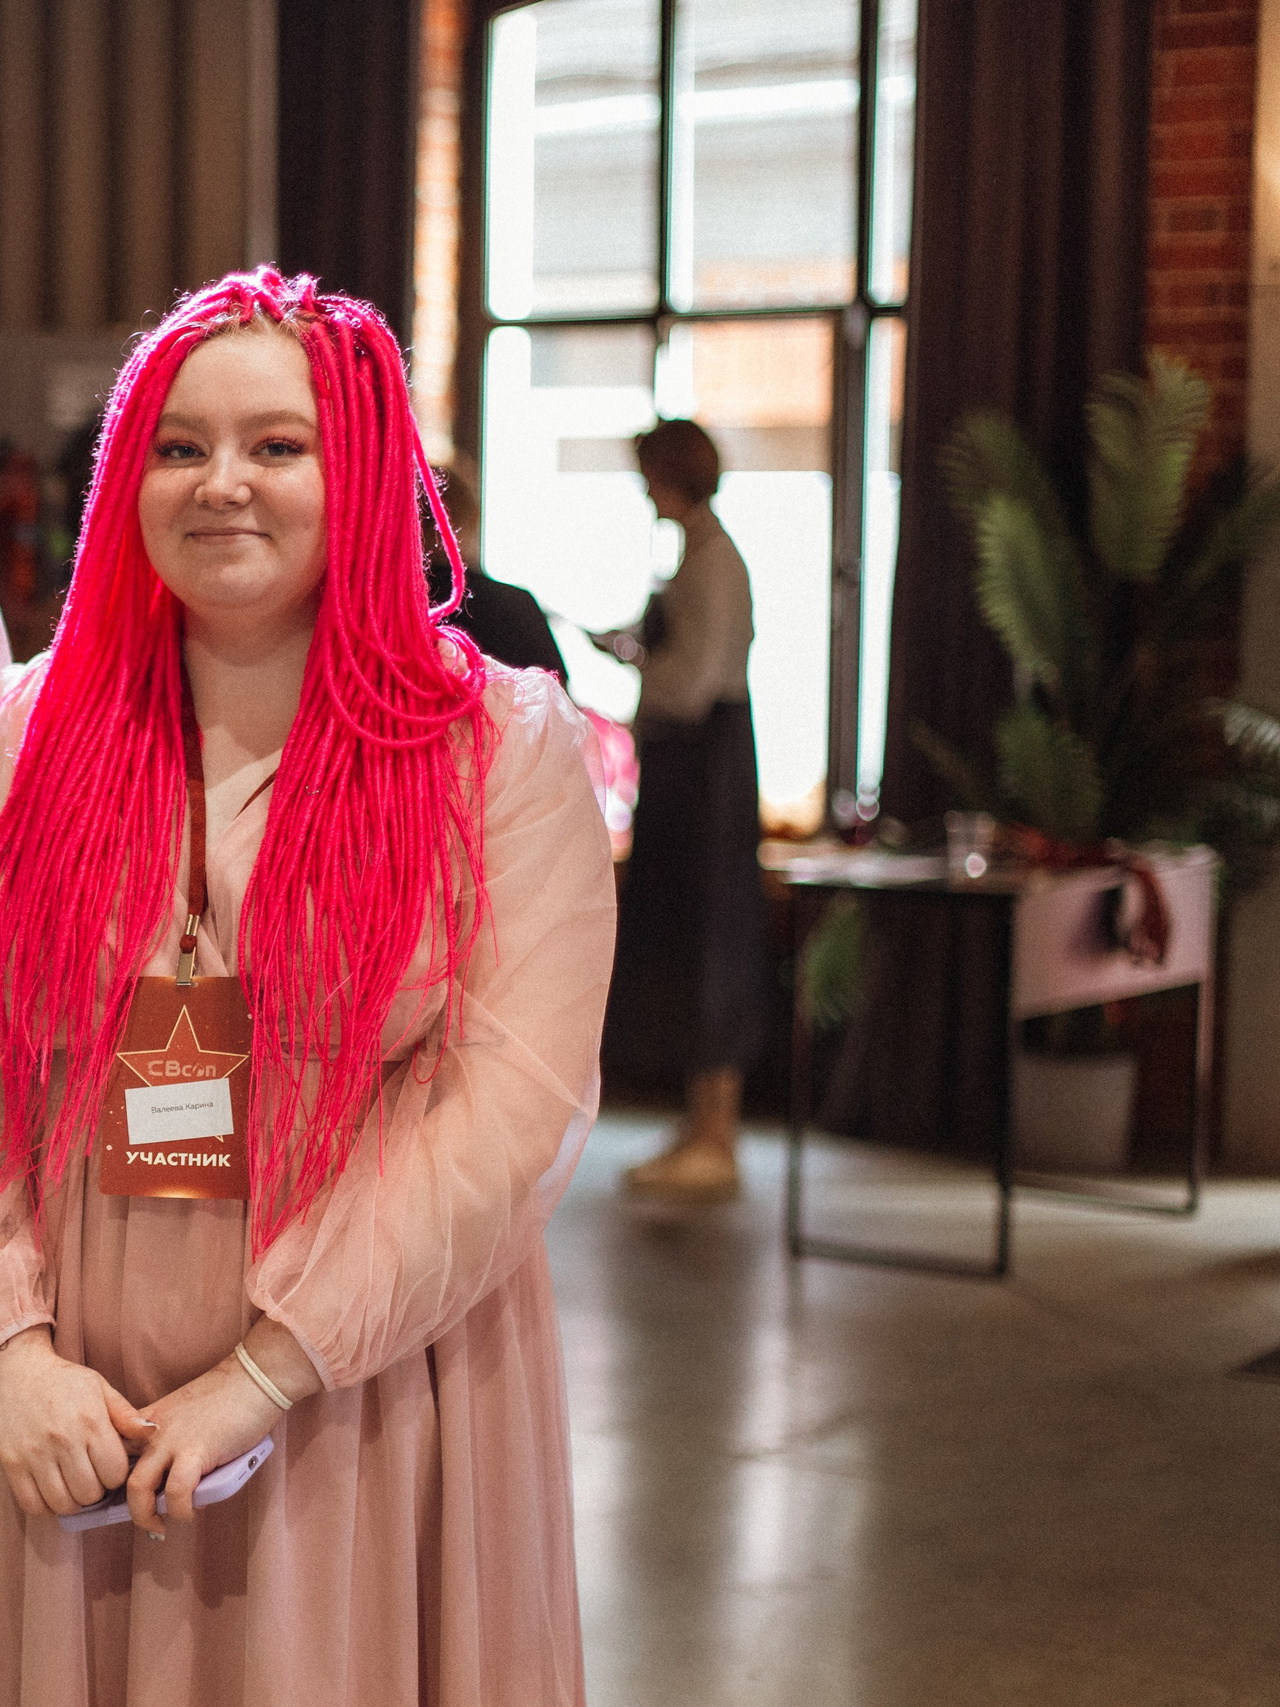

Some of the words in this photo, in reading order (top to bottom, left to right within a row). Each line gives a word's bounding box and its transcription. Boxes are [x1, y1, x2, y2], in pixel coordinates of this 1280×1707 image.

[151, 1105, 184, 1114] Валеева
[185, 1101, 214, 1111] Карина
[126, 1151, 231, 1168] УЧАСТНИК
